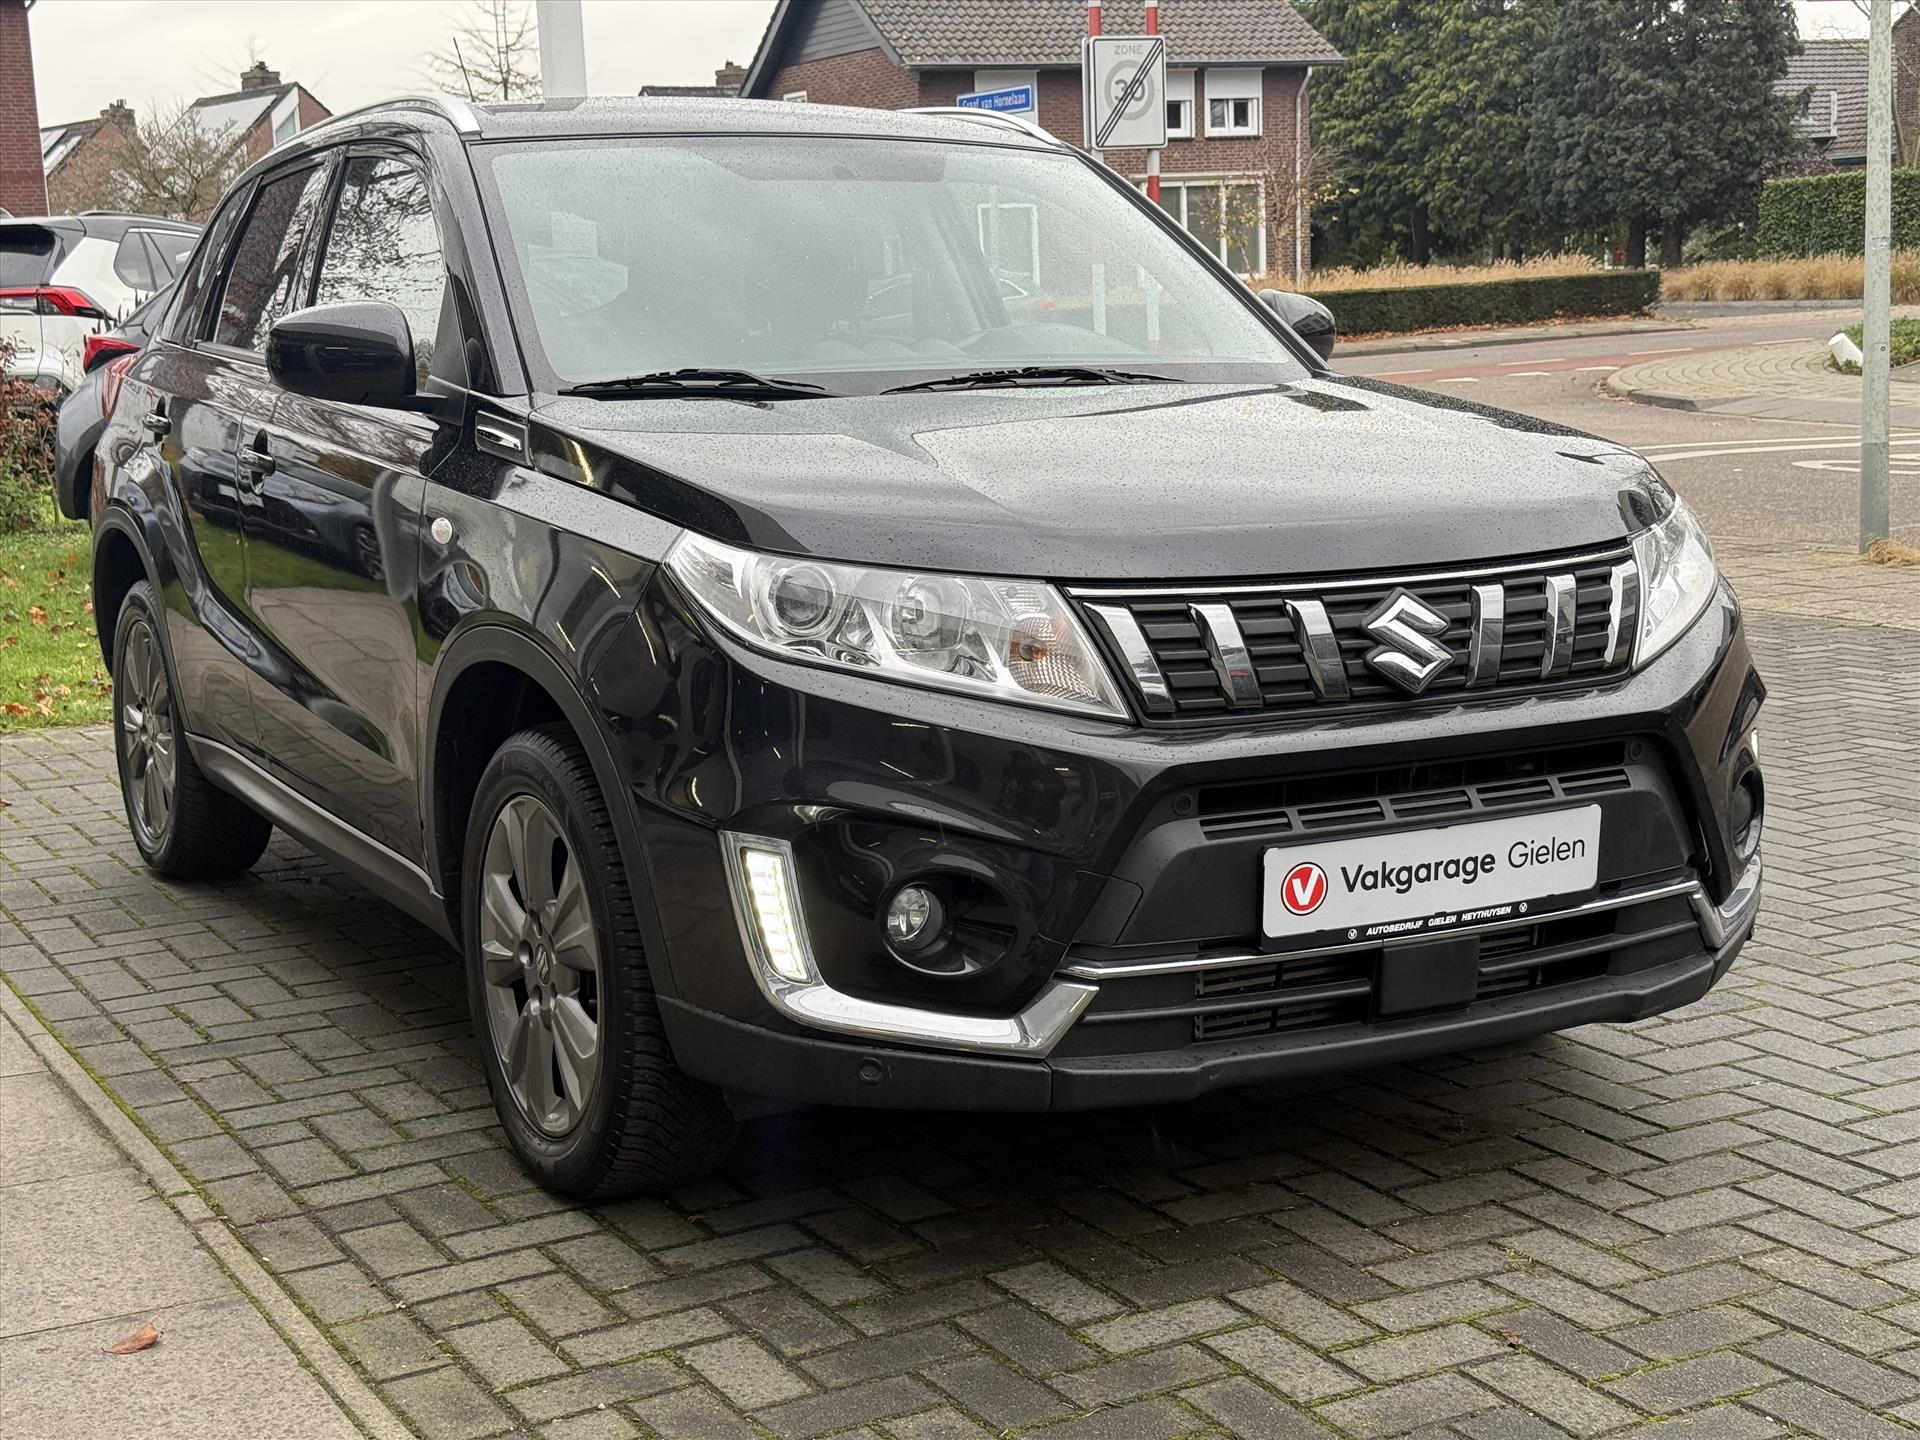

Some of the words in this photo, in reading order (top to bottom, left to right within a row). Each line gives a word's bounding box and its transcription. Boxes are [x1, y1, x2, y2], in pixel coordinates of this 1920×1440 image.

[1114, 45, 1143, 55] ZONE
[981, 99, 993, 109] van
[993, 93, 1026, 108] Hornelaan
[1340, 853, 1496, 894] Vakgarage
[1508, 836, 1585, 868] Gielen
[1366, 919, 1423, 936] AUTOBEDRIJF
[1428, 915, 1457, 927] GIELEN
[1461, 906, 1512, 922] HEYTHUYSEN
